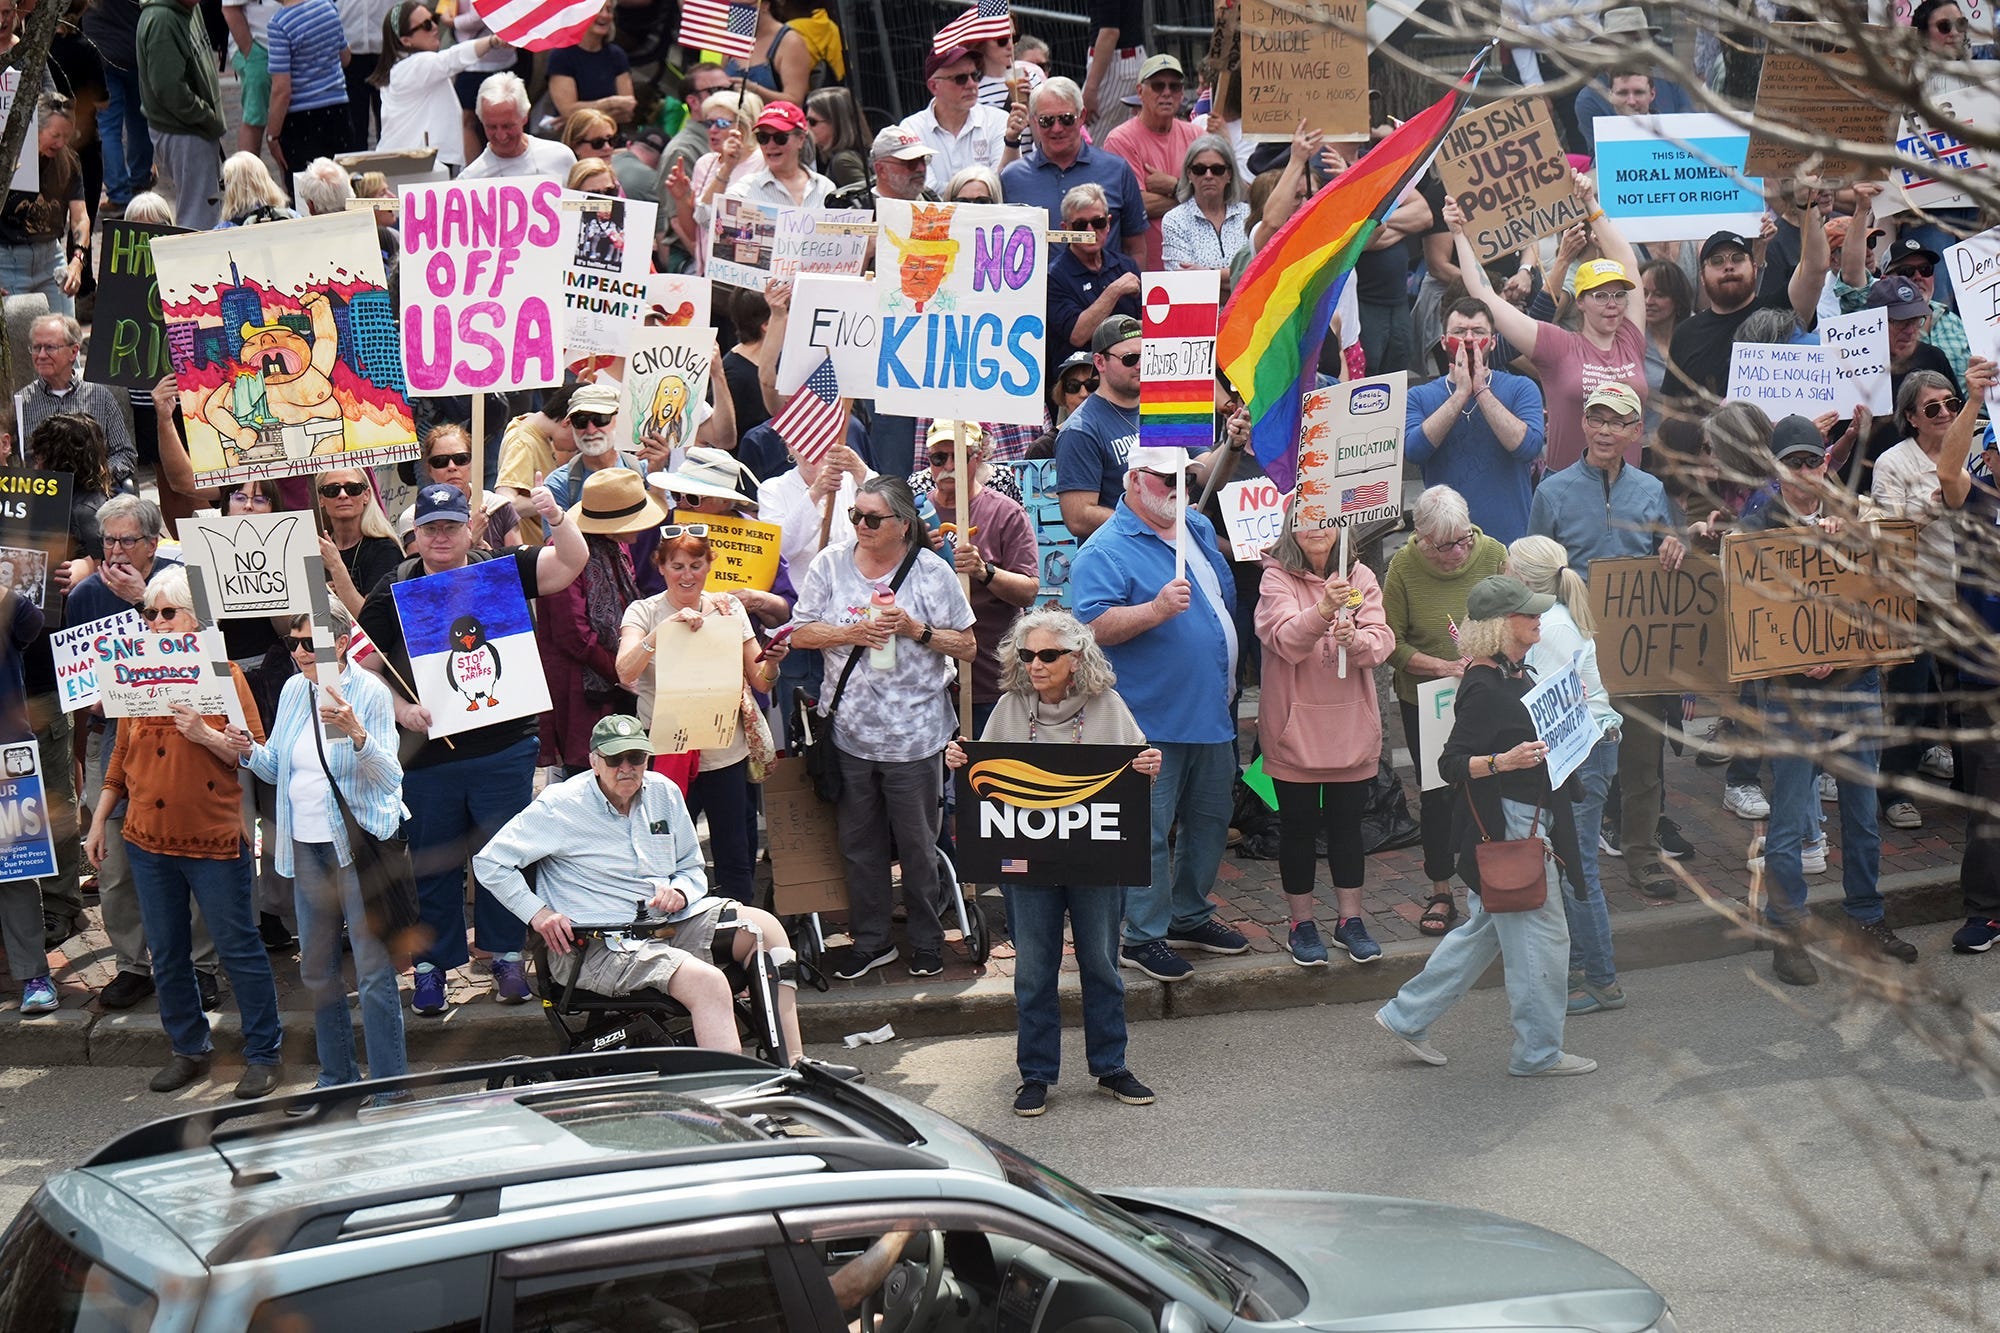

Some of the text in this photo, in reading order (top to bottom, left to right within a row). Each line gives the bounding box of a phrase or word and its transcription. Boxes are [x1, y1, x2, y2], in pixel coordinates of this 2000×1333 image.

[1251, 4, 1357, 25] IS MORE THAN
[1251, 29, 1349, 52] DOUBLE THE
[1252, 61, 1352, 80] MIN WAGE @
[1305, 90, 1320, 101] 40
[1440, 97, 1536, 162] THIS ISN'T
[1652, 151, 1694, 160] THIS IS A
[1616, 168, 1671, 182] MORAL
[1501, 195, 1537, 222] IT'S
[1618, 190, 1740, 205] NOT LEFT OR RIGHT
[404, 181, 562, 254] HANDS
[780, 209, 814, 235] TWO
[1478, 195, 1586, 259] SURVIVAL
[851, 239, 866, 256] IN
[972, 224, 1036, 293] NO
[426, 248, 521, 298] OFF
[708, 261, 759, 289] AMERICA
[774, 258, 860, 276] THE WOOD AND
[562, 270, 647, 300] IMPEACH
[809, 308, 876, 348] ENO
[1826, 318, 1884, 342] Protect
[404, 296, 555, 391] USA
[876, 312, 1045, 397] KINGS
[1840, 346, 1870, 360] Due
[632, 345, 709, 385] ENOUGH
[1178, 340, 1216, 375] OFF!
[1737, 349, 1825, 364] THIS MADE ME
[1738, 365, 1831, 385] MAD ENOUGH
[1733, 386, 1834, 401] TO HOLD A SIGN
[1338, 438, 1397, 461] EDUCATION
[0, 501, 27, 519] LS
[1240, 486, 1279, 511] NO
[1237, 513, 1280, 541] ICE
[1319, 504, 1400, 530] CONSTITUTION
[731, 527, 775, 542] OF MERCY
[709, 539, 763, 555] TOGETHER
[234, 551, 267, 572] NO
[726, 556, 743, 567] WE
[1735, 547, 1774, 586] WE
[1776, 547, 1800, 570] THE
[224, 571, 285, 595] KINGS
[1603, 569, 1719, 619] HANDS
[54, 612, 142, 647] UNCHECKE
[1731, 607, 1767, 662] WE
[94, 633, 201, 662] SAVE OUR
[1619, 622, 1708, 677] OFF!
[457, 650, 486, 671] STOP
[465, 662, 482, 674] THE
[66, 671, 98, 697] EN
[460, 667, 492, 683] TARIFFS
[108, 689, 142, 701] HANDS
[1530, 677, 1572, 734] PEOPLE
[17, 761, 22, 772] 1
[979, 800, 1121, 841] NOPE
[12, 850, 47, 860] Free Press
[18, 858, 45, 867] Process
[8, 868, 23, 876] Law
[592, 1029, 627, 1050] Jazzy
